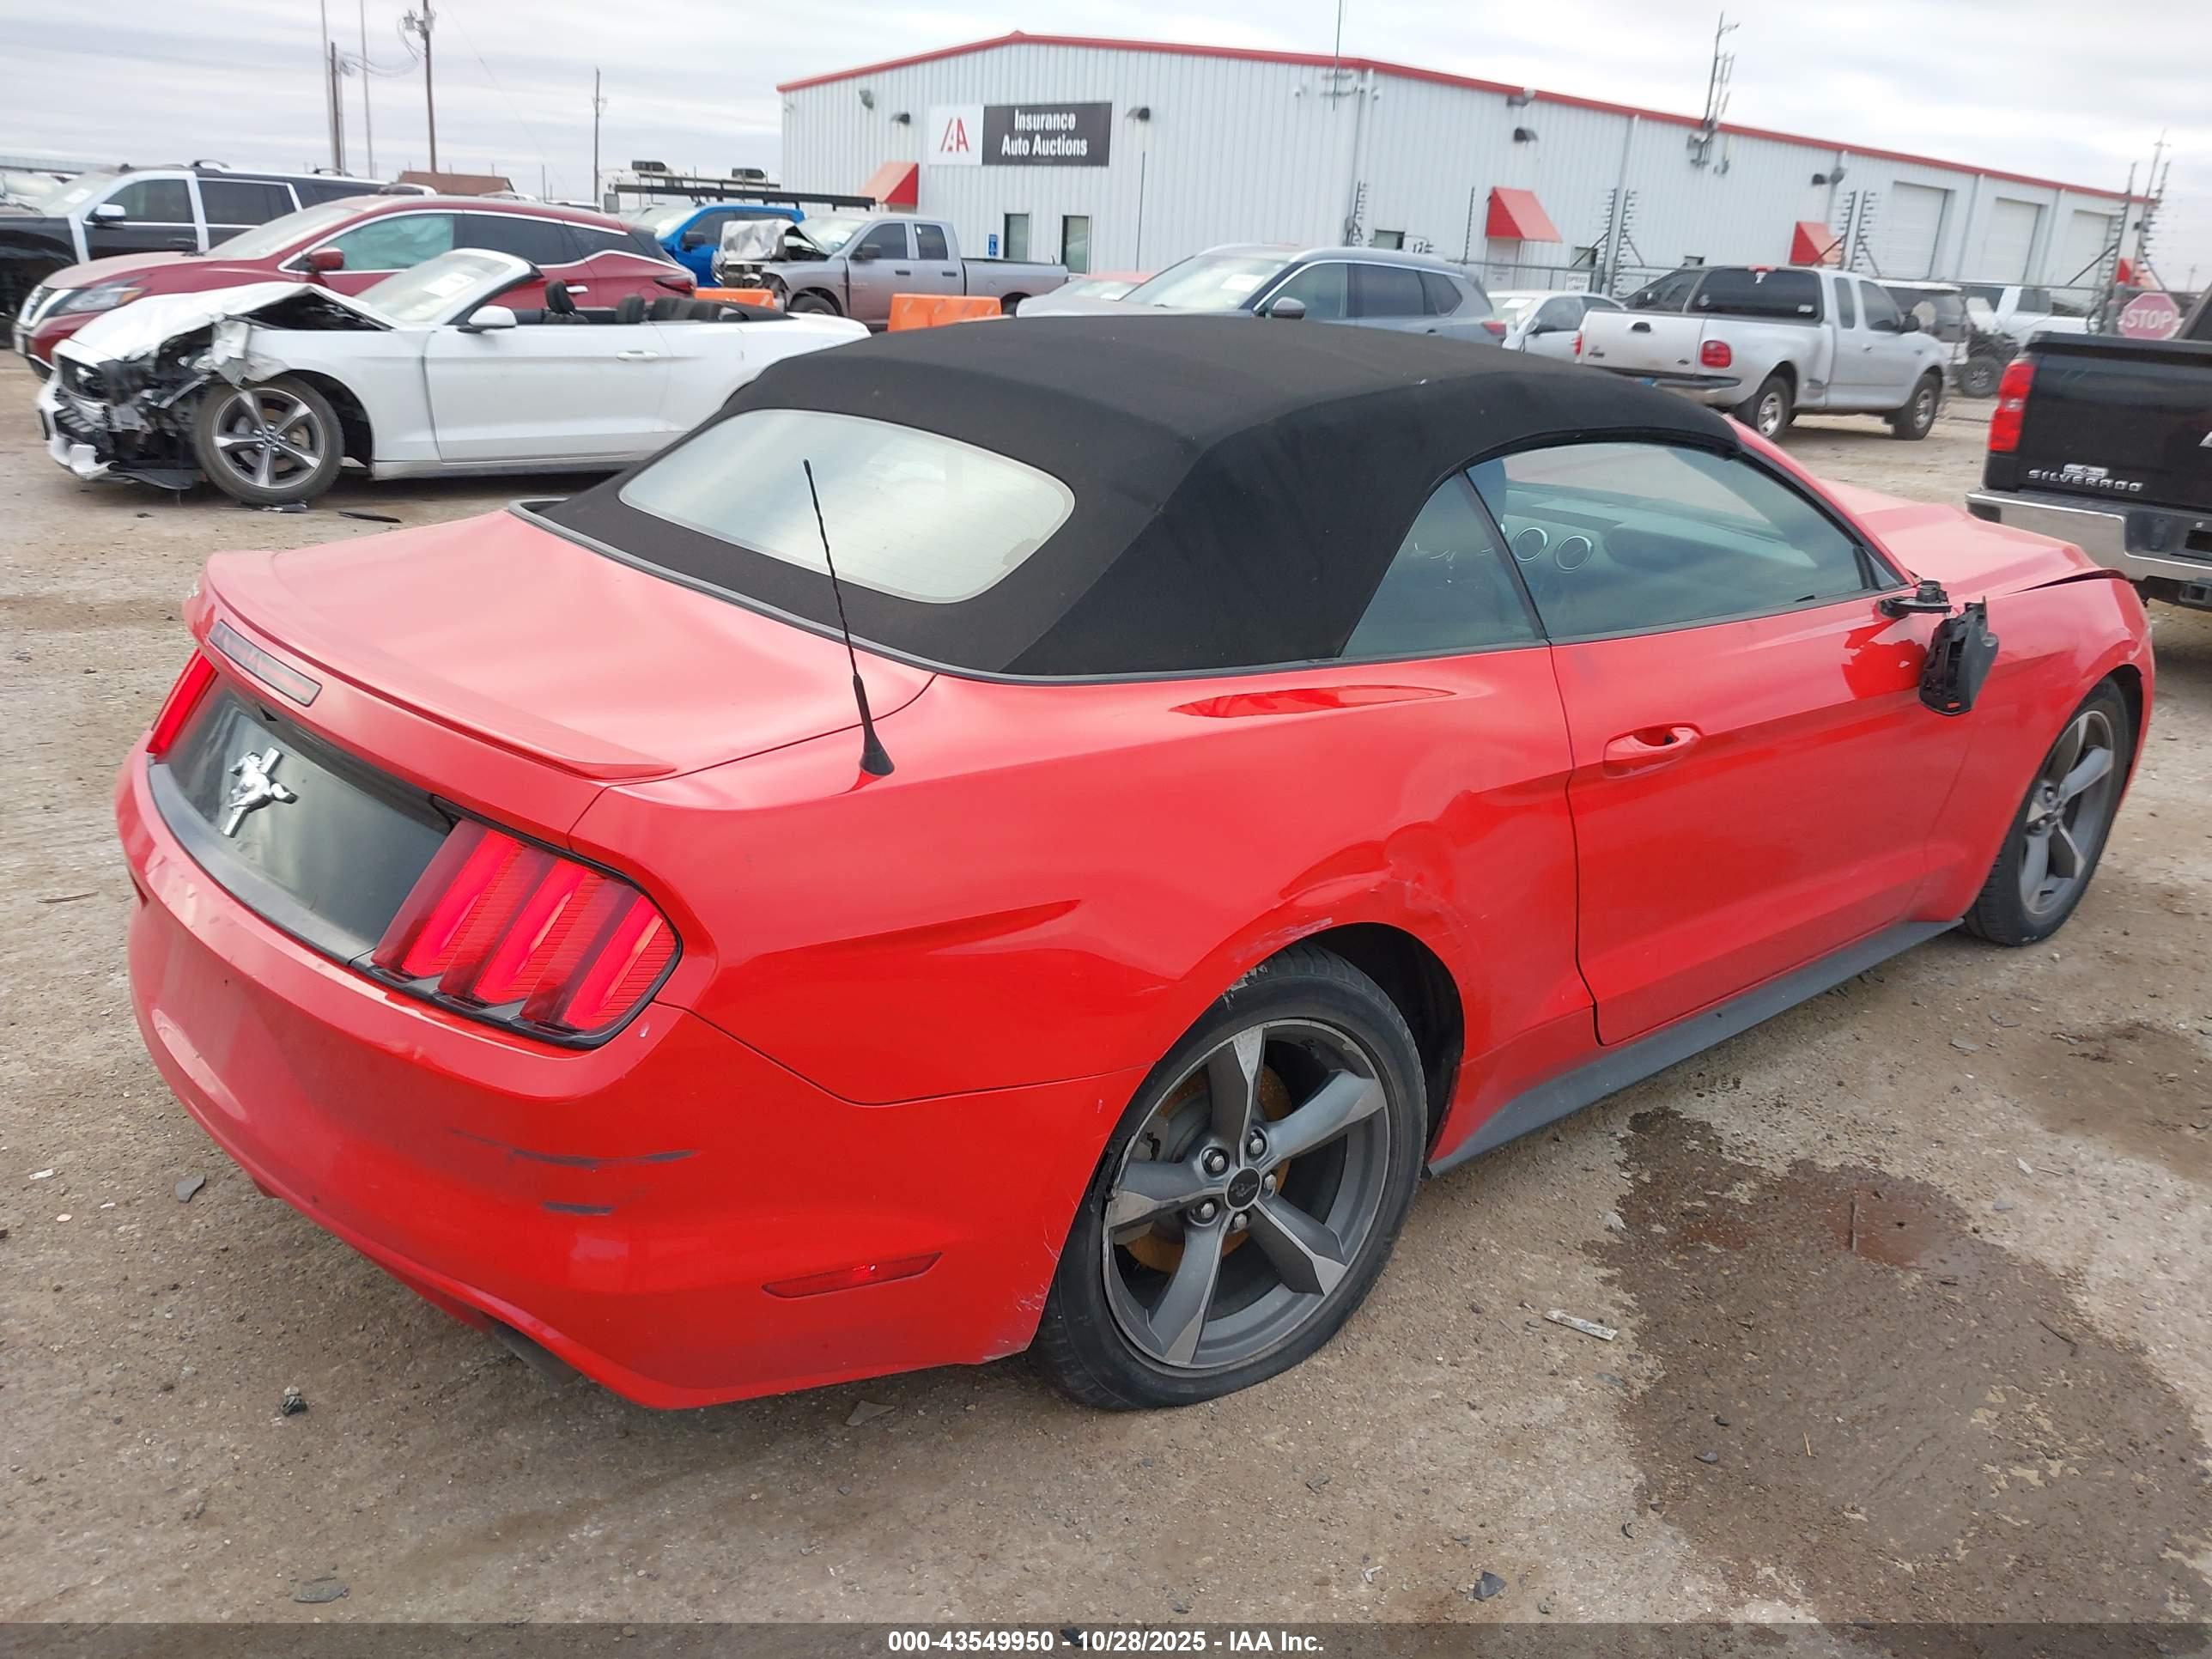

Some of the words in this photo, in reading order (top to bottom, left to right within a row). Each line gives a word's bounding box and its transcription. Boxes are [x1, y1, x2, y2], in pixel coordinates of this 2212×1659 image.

[1014, 108, 1077, 131] Insurance
[1001, 134, 1030, 156] Auto
[1032, 133, 1088, 156] Auctions
[2126, 308, 2173, 330] STOP
[2027, 468, 2144, 492] SILVERADO
